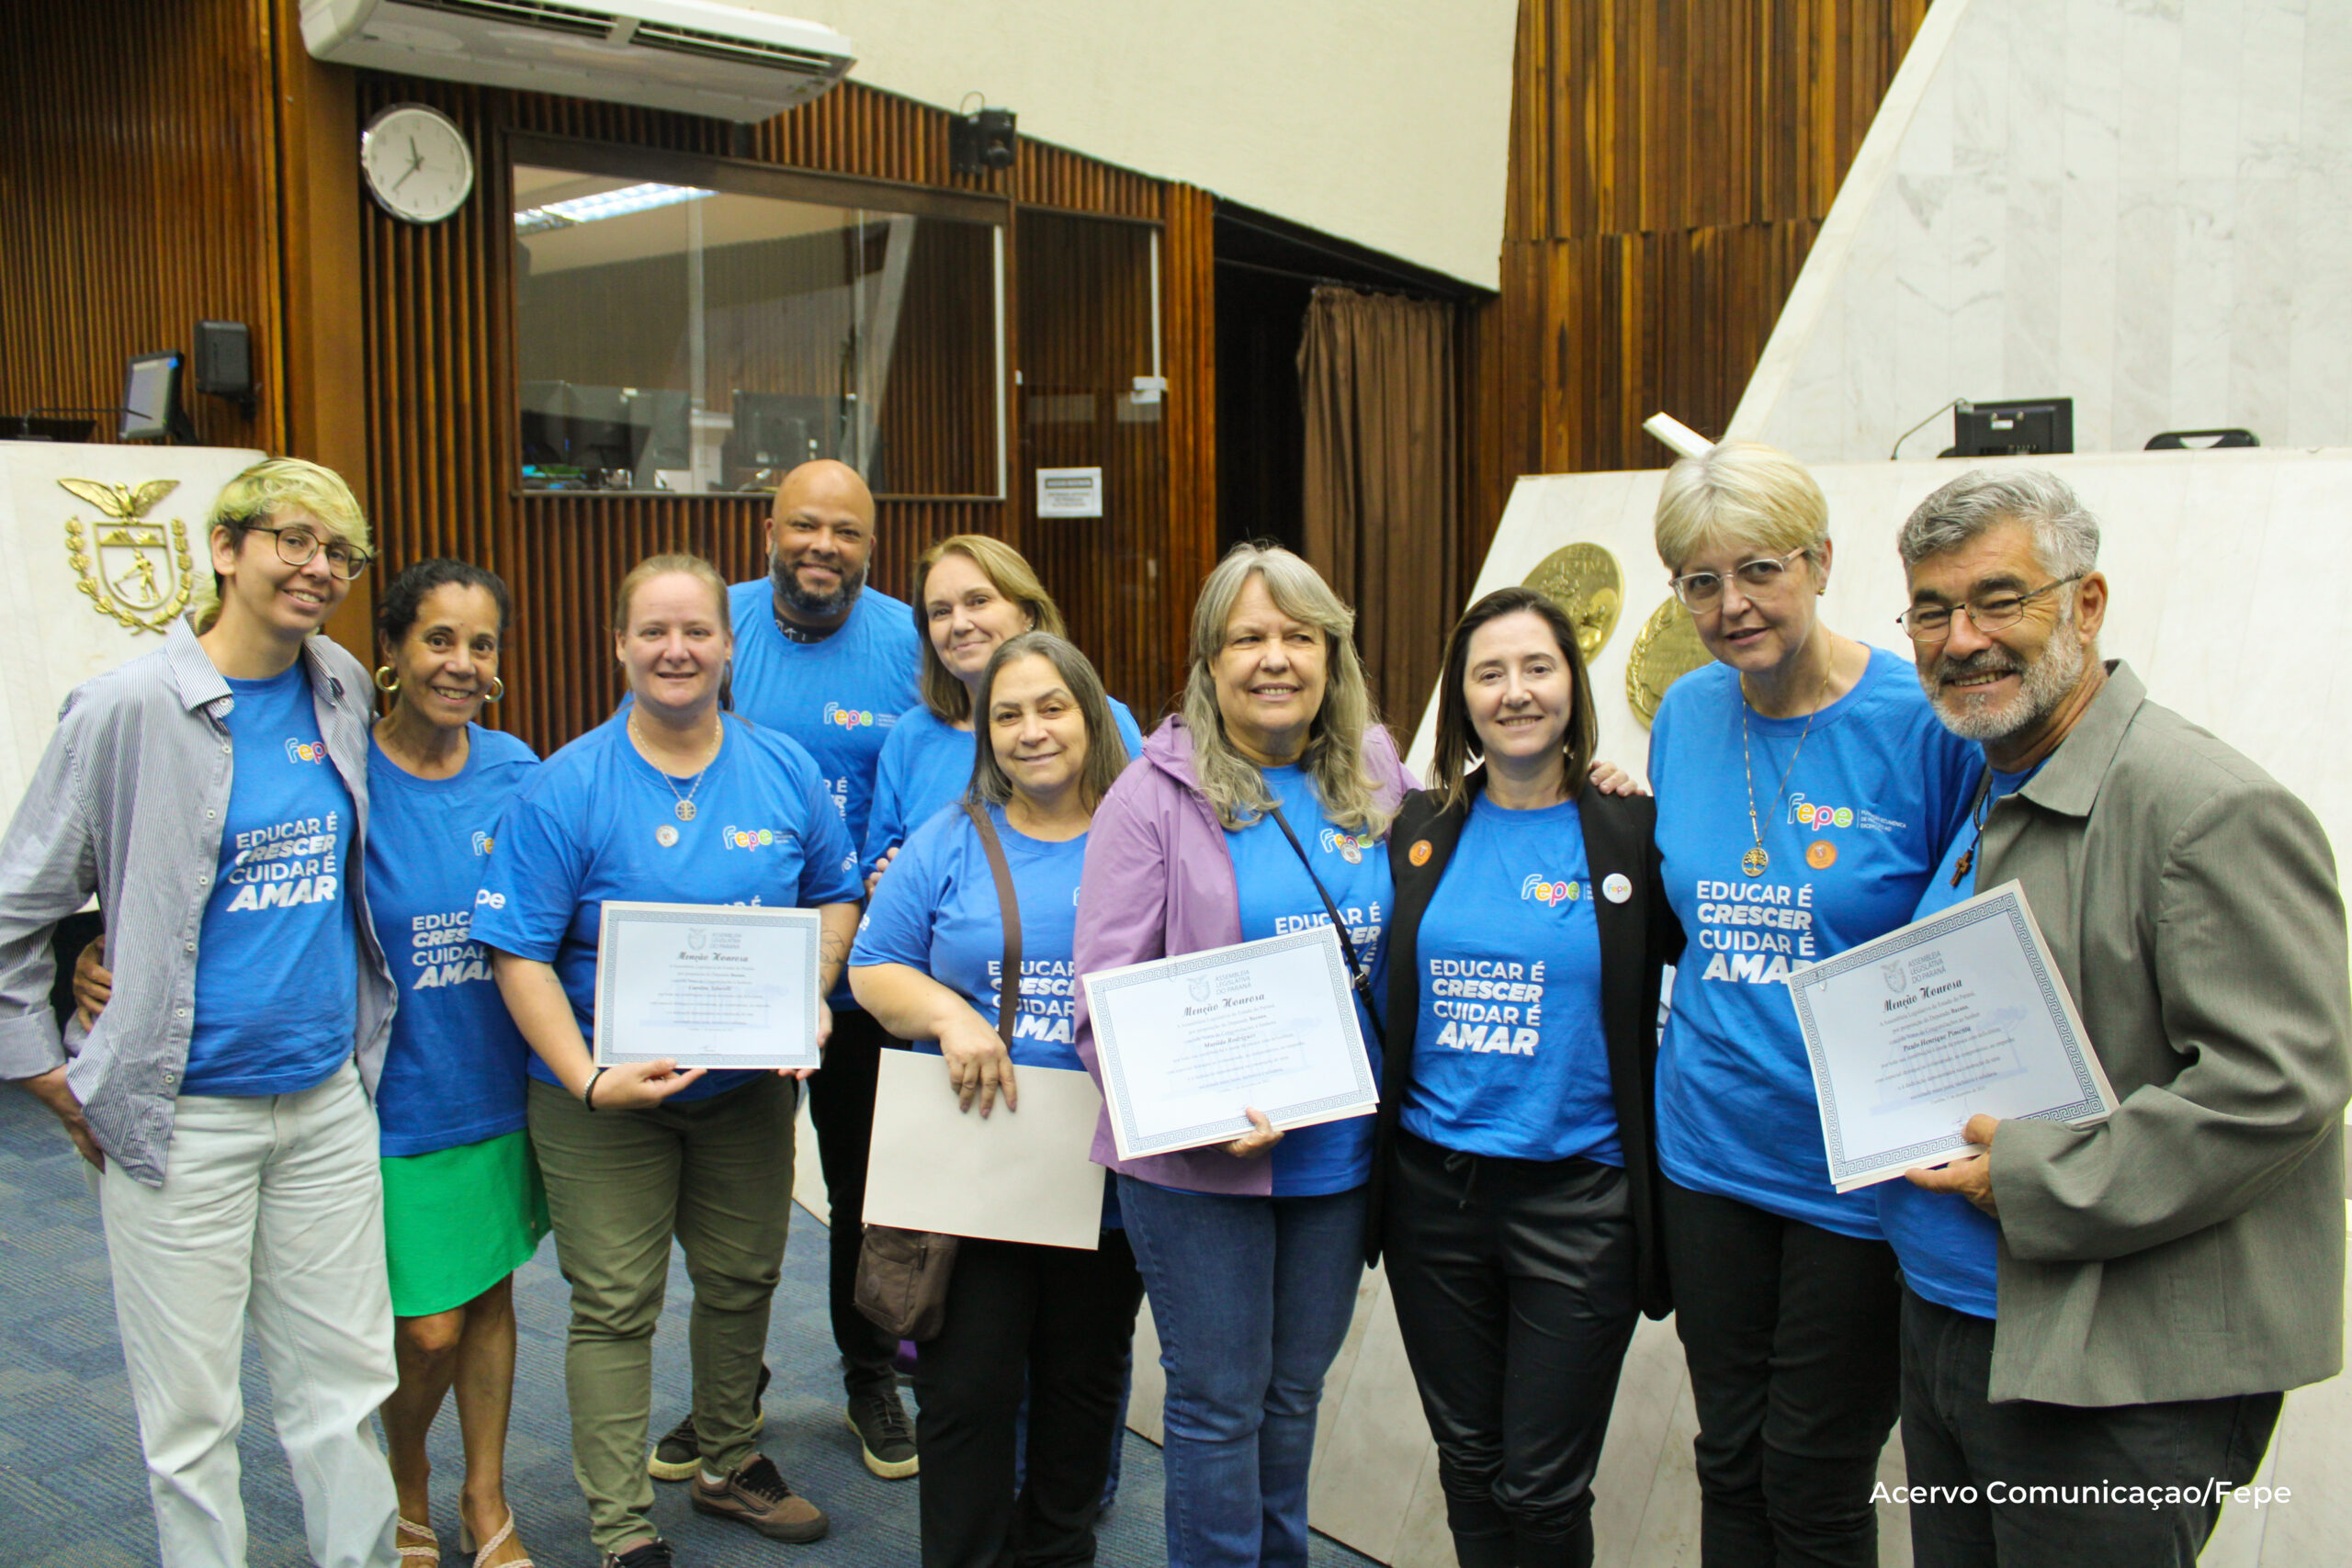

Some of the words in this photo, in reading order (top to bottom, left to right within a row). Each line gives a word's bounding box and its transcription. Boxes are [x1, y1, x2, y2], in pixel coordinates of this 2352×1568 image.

[285, 737, 326, 764] fep
[236, 818, 322, 850] EDUCAR
[326, 810, 338, 831] É
[234, 833, 337, 867] CRESCER
[228, 858, 320, 885] CUIDAR
[322, 851, 337, 873] É
[225, 874, 337, 912] AMAR
[1696, 879, 1792, 906] EDUCAR
[1797, 883, 1814, 908] É
[412, 911, 473, 931] EDUC
[1369, 901, 1382, 923] É
[1697, 902, 1813, 931] CRESCER
[412, 927, 471, 948] CRES
[1698, 929, 1792, 954] CUIDAR
[1798, 931, 1815, 956] É
[412, 960, 494, 989] AMA
[1430, 959, 1523, 980] EDUCAR
[1530, 960, 1546, 983] É
[1431, 978, 1544, 1003] CRESCER
[1882, 994, 1917, 1013] Menção
[1919, 978, 1963, 1000] Honrosa
[1432, 999, 1520, 1025] CUIDAR
[1525, 1003, 1542, 1027] É
[1435, 1021, 1541, 1056] AMAR
